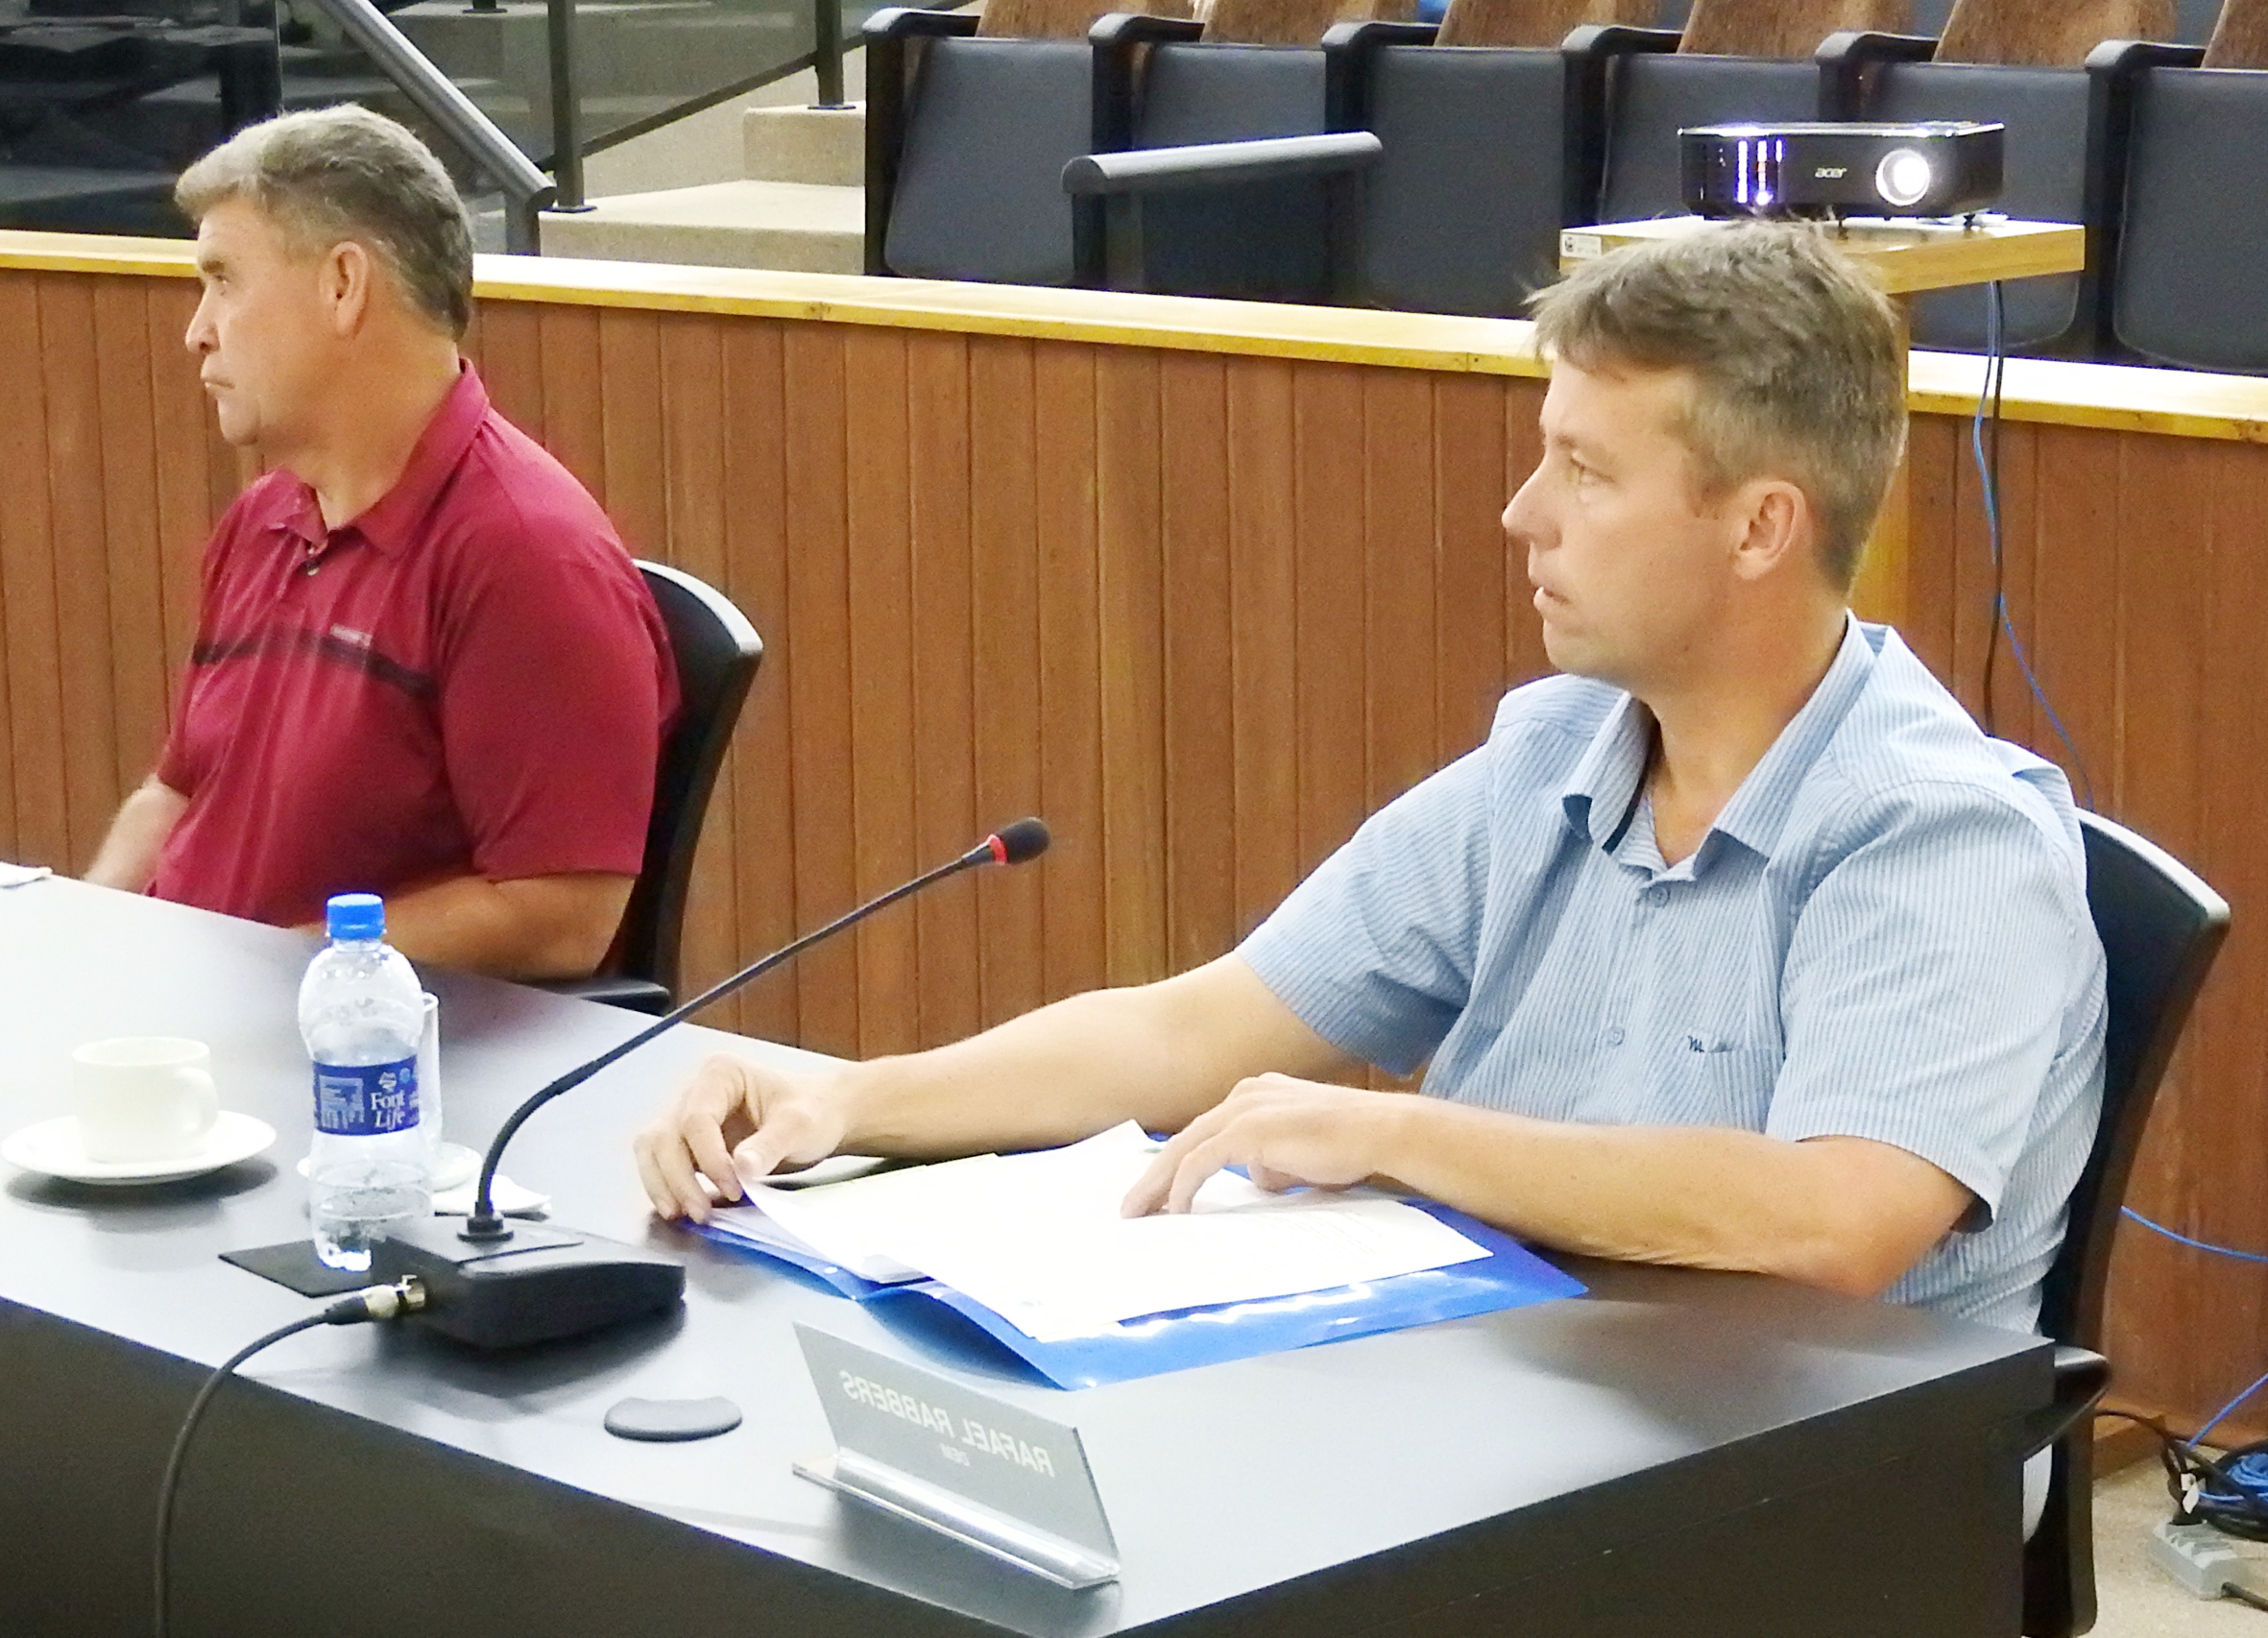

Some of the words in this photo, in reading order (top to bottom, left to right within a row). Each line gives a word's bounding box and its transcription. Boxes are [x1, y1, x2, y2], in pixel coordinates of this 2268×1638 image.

[1814, 167, 1847, 179] acer
[371, 1089, 405, 1110] Font
[374, 1109, 405, 1130] Life
